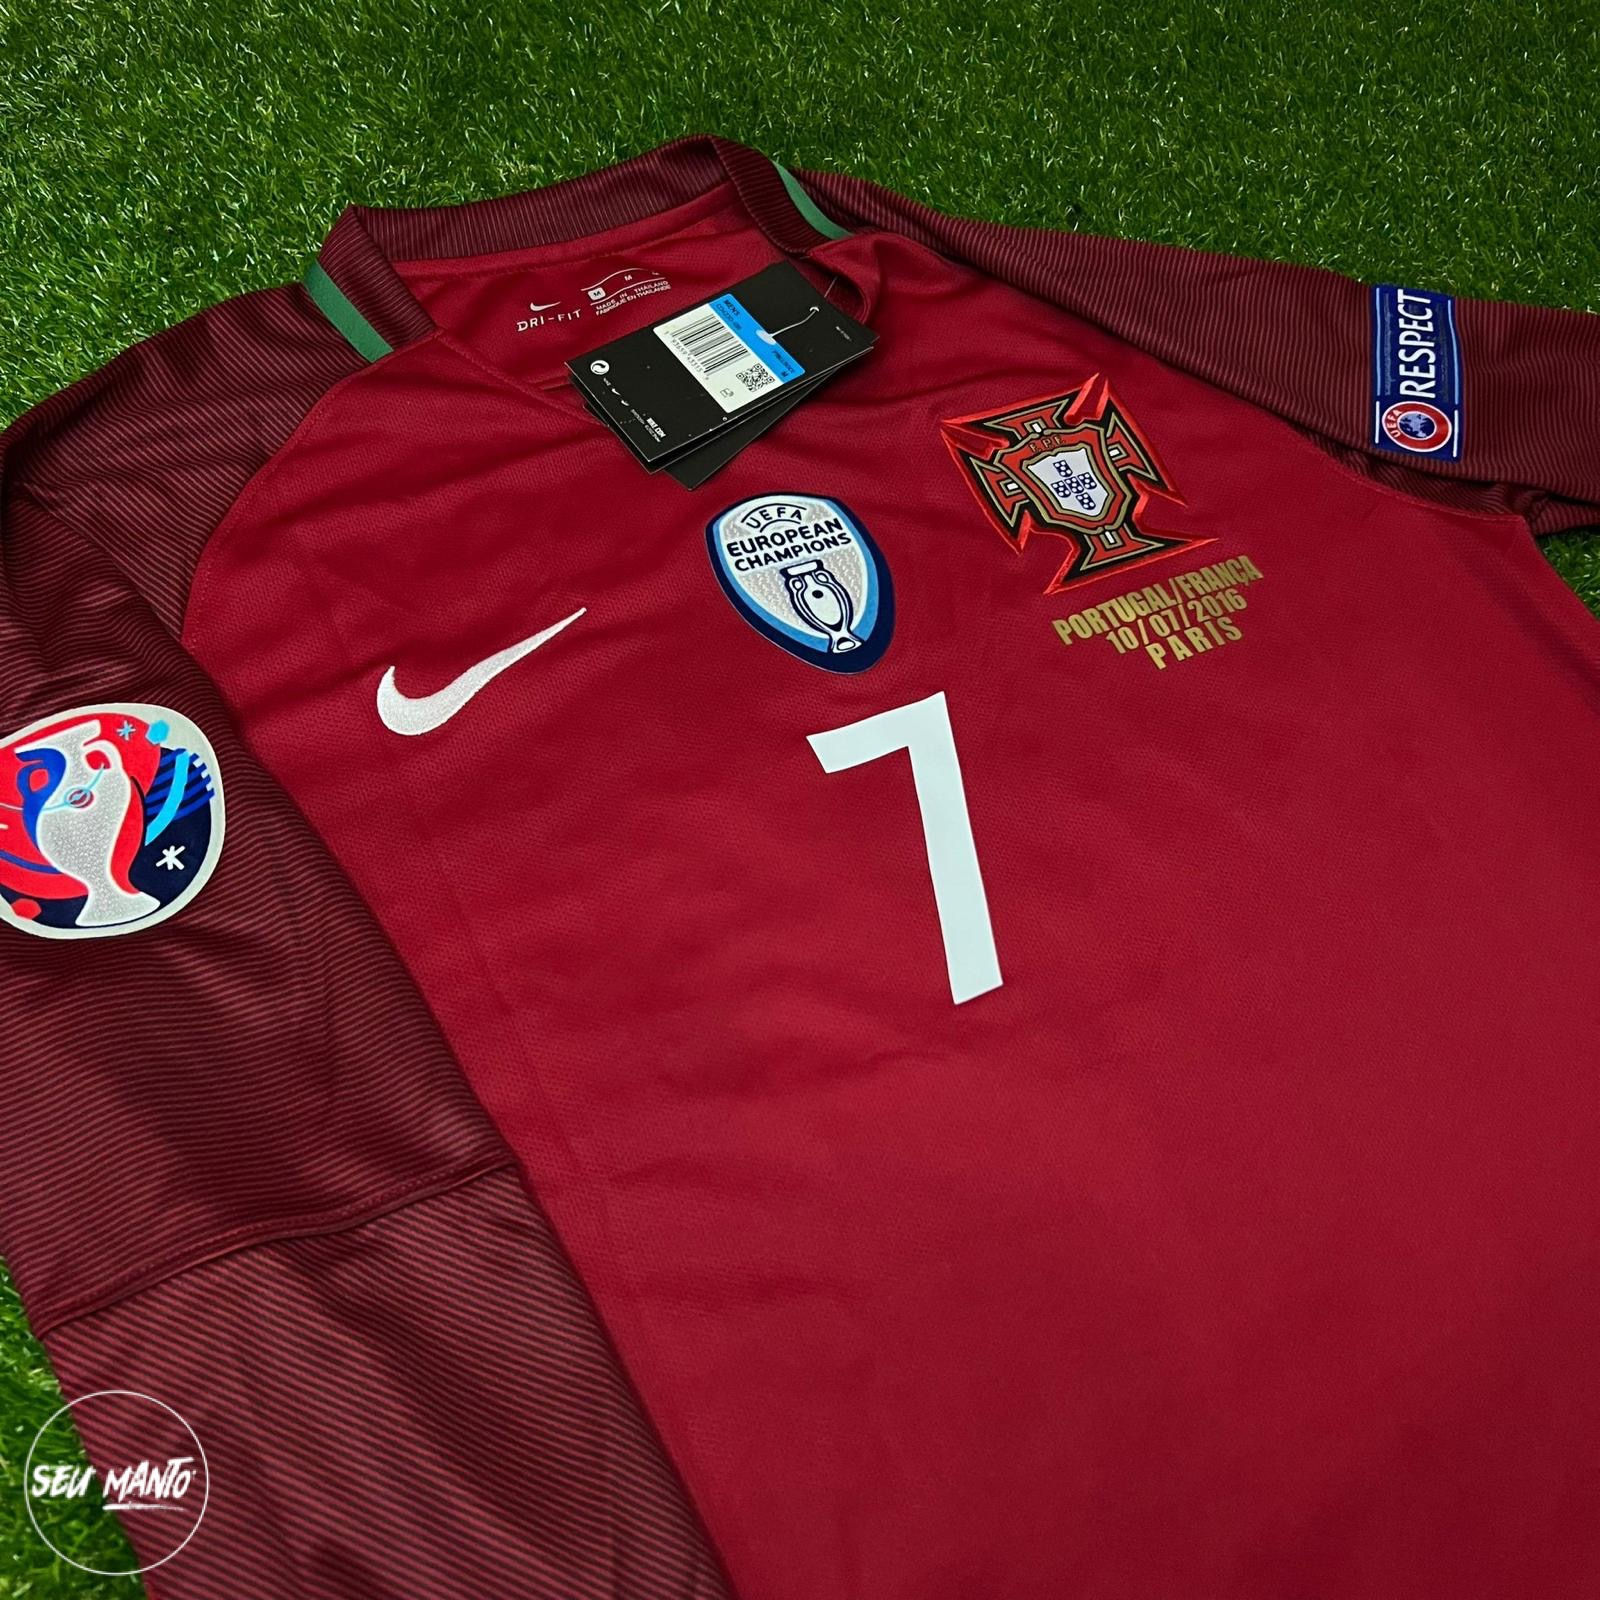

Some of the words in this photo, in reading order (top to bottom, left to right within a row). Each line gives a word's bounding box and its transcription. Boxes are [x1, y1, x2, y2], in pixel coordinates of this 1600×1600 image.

[516, 309, 581, 332] DRI-FIT
[1397, 288, 1436, 398] RESPECT
[1386, 409, 1402, 438] UEFA
[726, 518, 844, 557] EUROPEAN
[746, 506, 802, 529] UEFA
[734, 532, 852, 571] CHAMPIONS
[1052, 555, 1264, 646] PORTUGAL/FRANÇA
[1105, 588, 1248, 654] 10/07/2016
[1145, 616, 1243, 670] PARIS
[806, 691, 1003, 1005] 7
